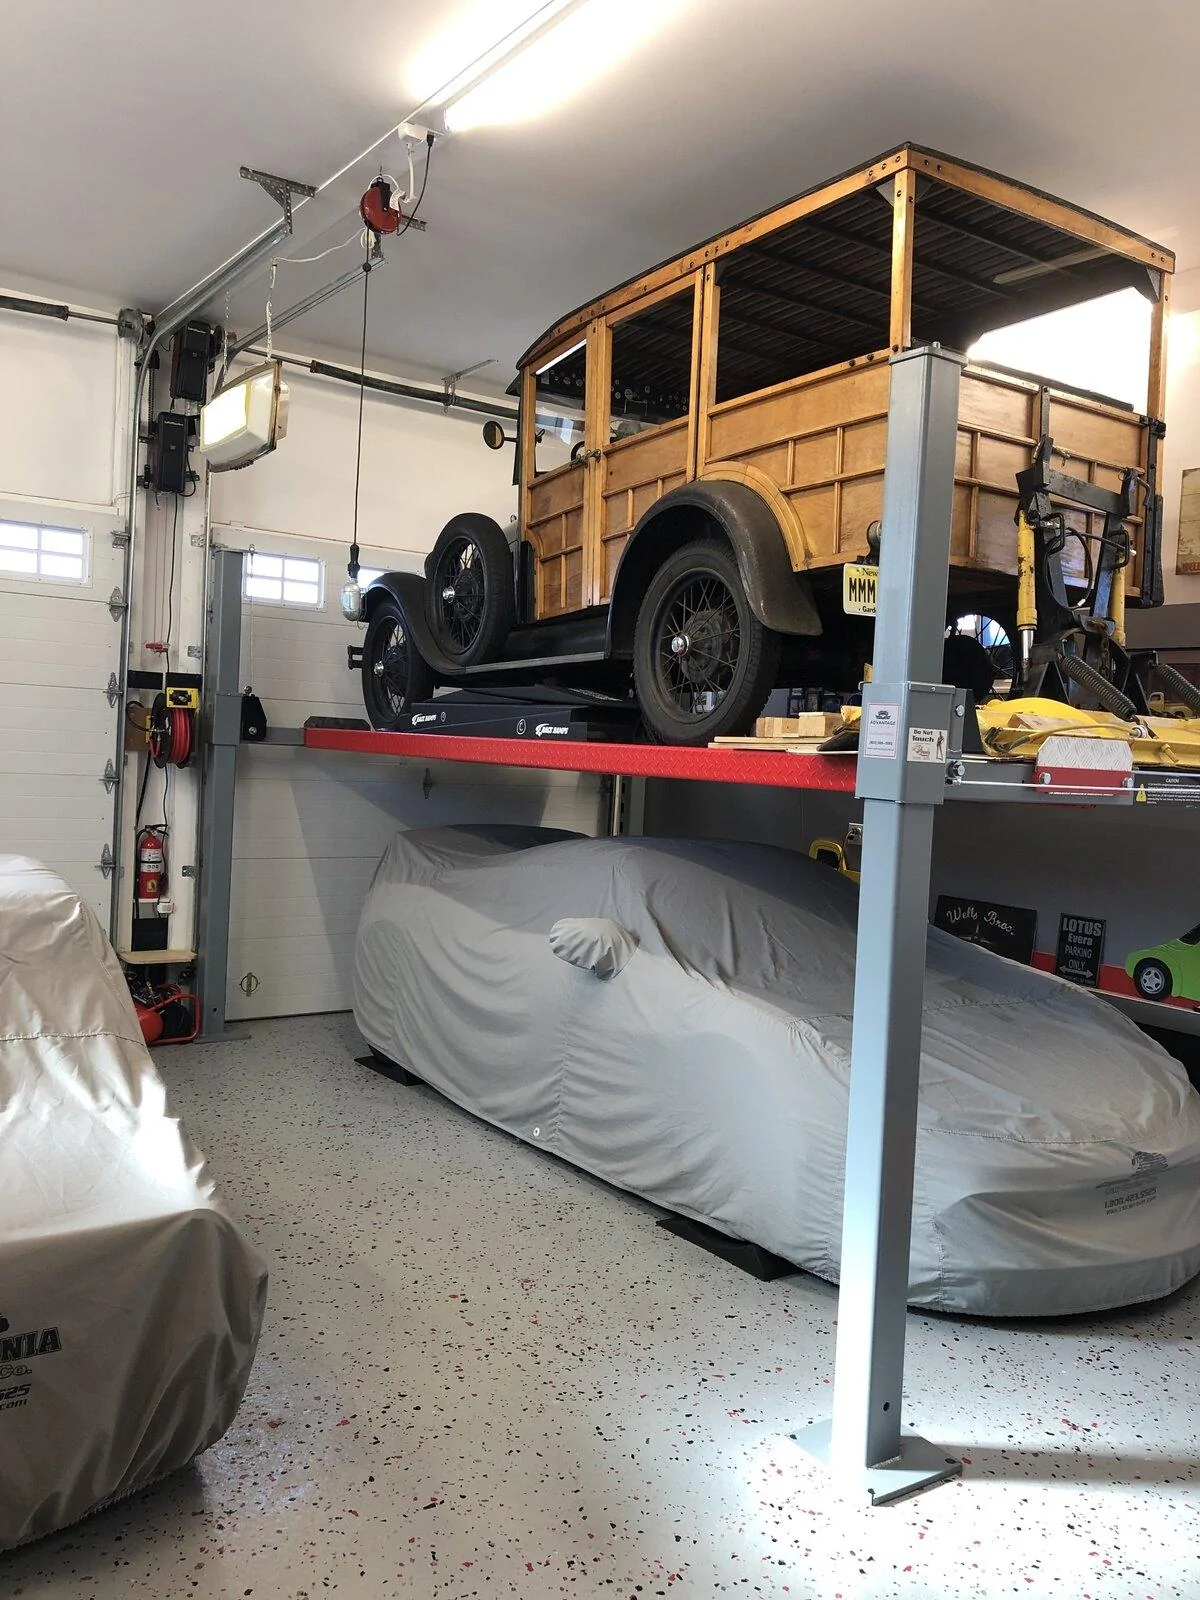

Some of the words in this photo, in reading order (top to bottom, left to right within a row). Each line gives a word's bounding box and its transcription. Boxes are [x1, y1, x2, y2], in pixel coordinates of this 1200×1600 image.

[862, 567, 879, 577] New
[848, 577, 876, 604] MMM
[945, 905, 978, 924] Wells
[1062, 917, 1102, 937] LOTUS
[1064, 944, 1093, 960] PARKING
[1068, 959, 1086, 971] ONLY
